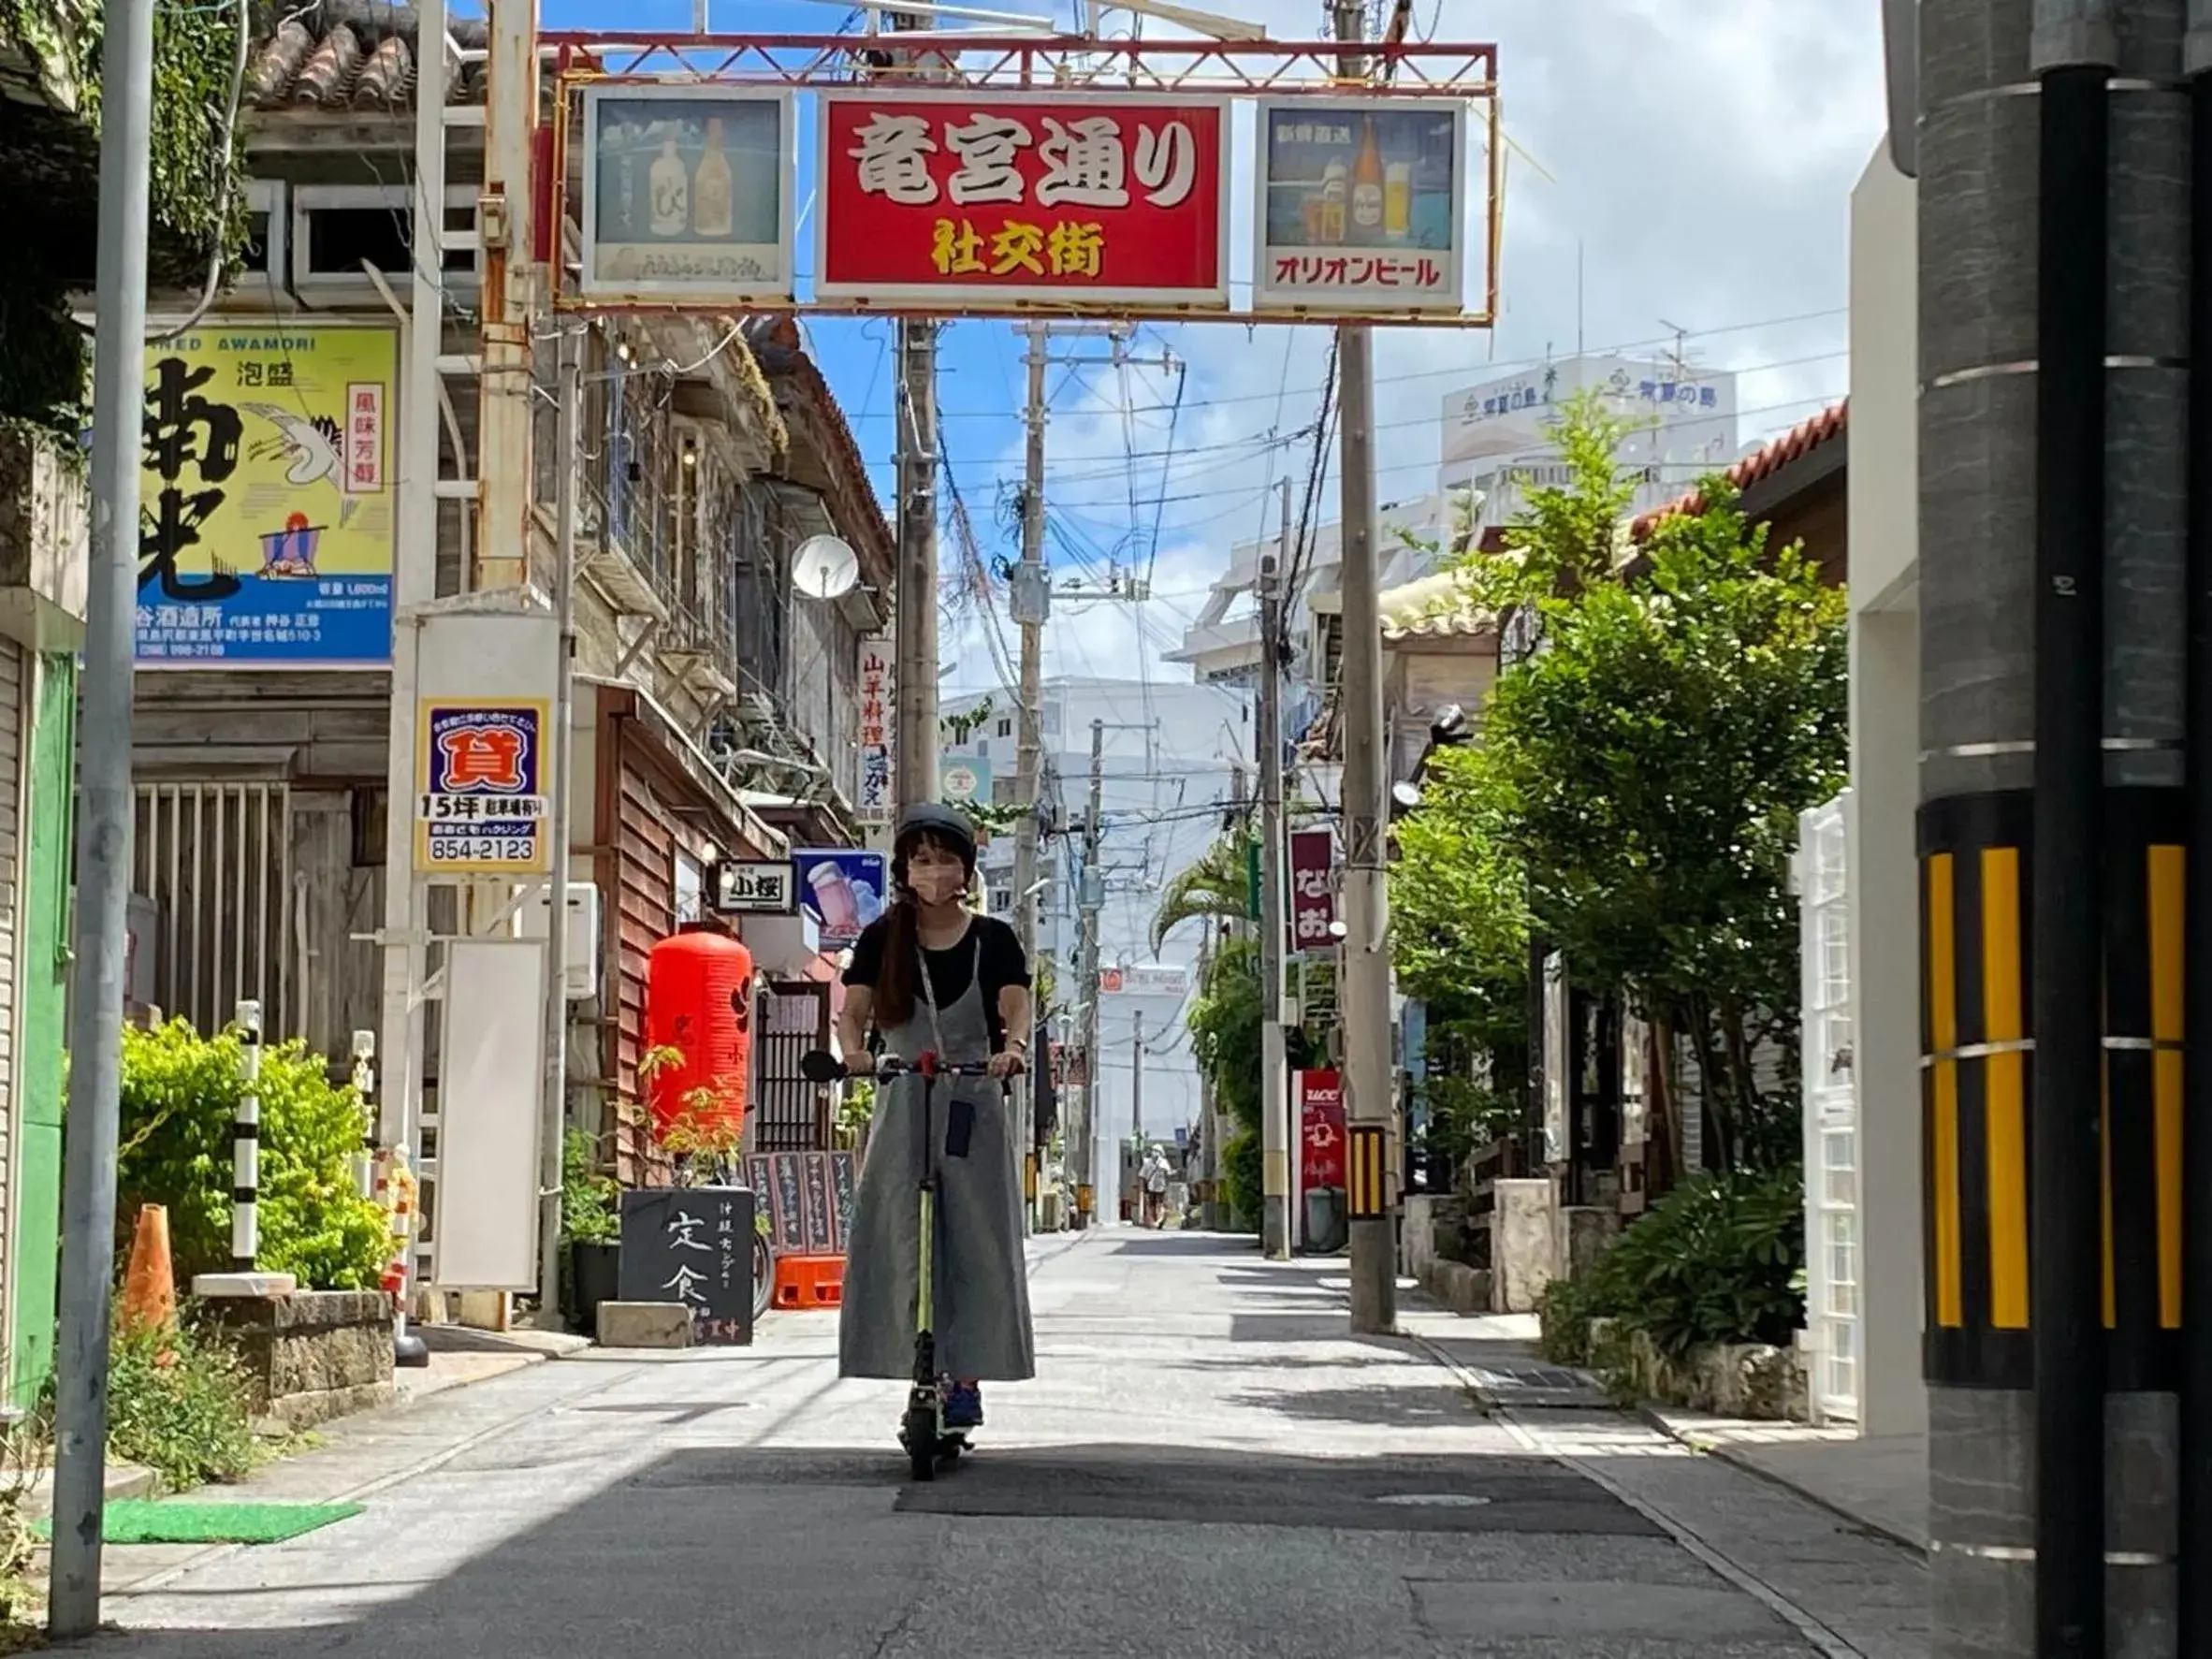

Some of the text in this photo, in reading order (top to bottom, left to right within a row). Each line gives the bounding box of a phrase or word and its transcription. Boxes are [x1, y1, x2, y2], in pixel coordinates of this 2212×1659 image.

[848, 111, 1197, 208] 竜宮通り
[931, 218, 1104, 278] 社交街
[1275, 256, 1441, 285] オリオンビール
[218, 338, 316, 352] AWAMORI
[237, 361, 293, 387] 泡盛
[443, 728, 521, 788] 貸
[422, 796, 480, 820] 15坪
[432, 839, 533, 860] 854-2123
[662, 1211, 714, 1302] 定食
